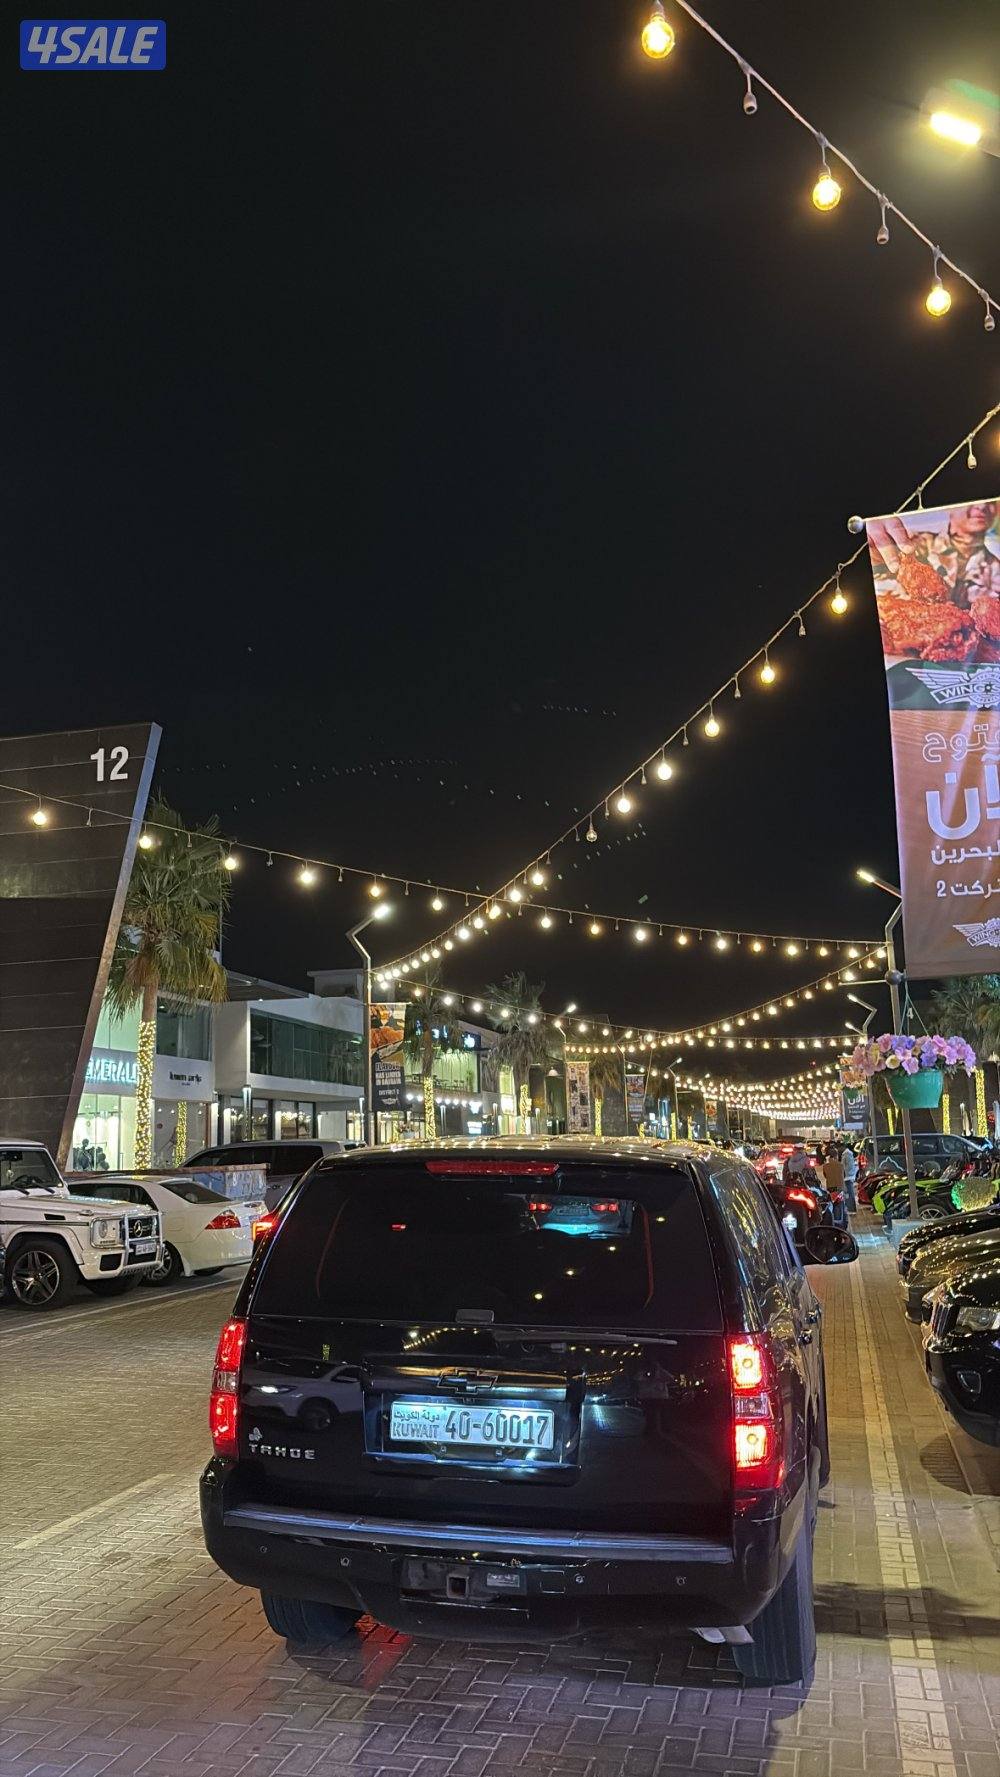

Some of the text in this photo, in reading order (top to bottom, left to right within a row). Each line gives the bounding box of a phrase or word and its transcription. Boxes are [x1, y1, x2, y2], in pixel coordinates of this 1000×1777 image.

[923, 723, 1000, 763] توح
[90, 746, 129, 782] 12
[936, 879, 947, 898] 2
[392, 1422, 440, 1438] KUWAIT
[445, 1410, 550, 1445] 40-60017
[248, 1443, 316, 1460] TAHOE
